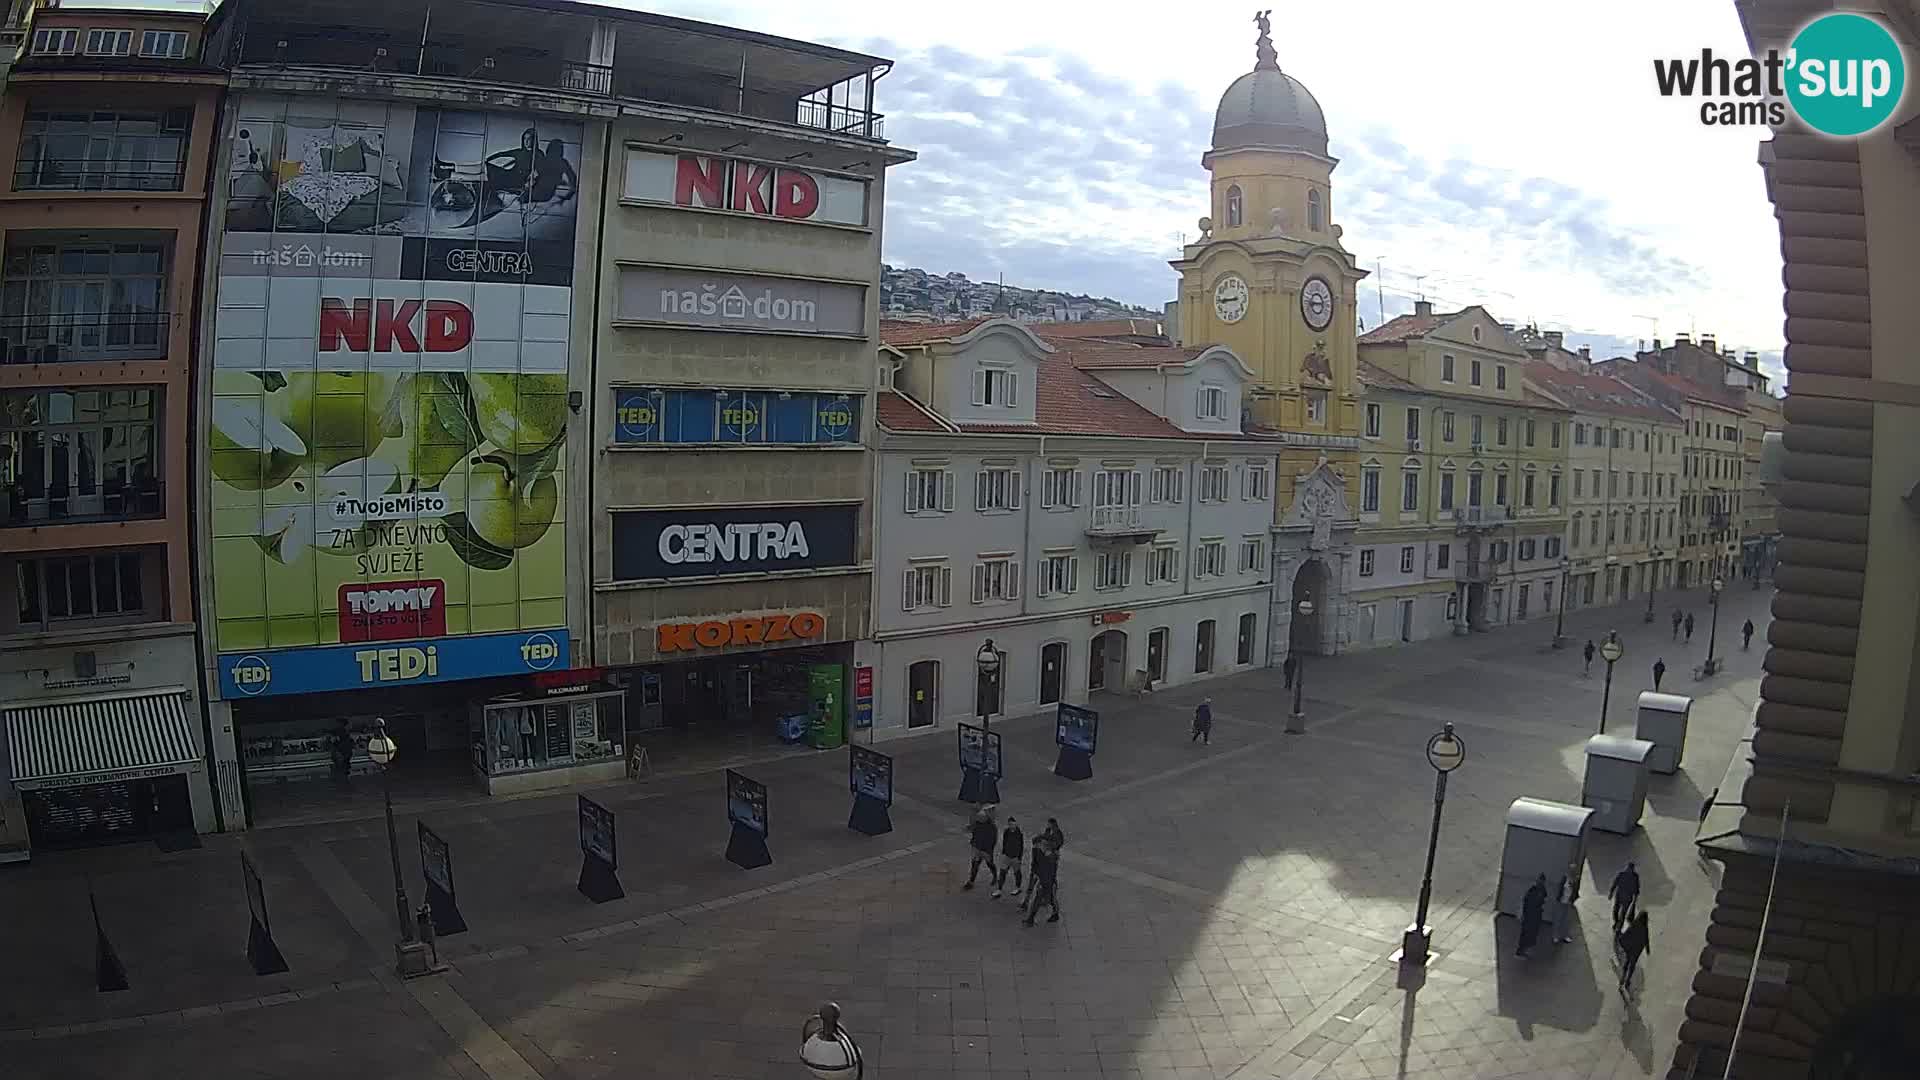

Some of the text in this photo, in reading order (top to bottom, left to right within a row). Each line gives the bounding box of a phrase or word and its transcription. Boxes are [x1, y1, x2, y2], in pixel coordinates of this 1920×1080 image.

[675, 155, 819, 219] NKD
[252, 244, 363, 268] naš dom
[446, 248, 534, 275] CENTRA
[660, 284, 816, 322] naš dom
[318, 296, 475, 353] NKD
[617, 407, 656, 424] TEDi
[723, 409, 758, 425] TEDi
[819, 411, 852, 426] TEDi
[335, 495, 445, 518] #TvojeMisto
[331, 523, 448, 549] ZA DNEVNO
[658, 520, 809, 564] CENTRA
[357, 548, 425, 575] SVJEŽE
[346, 586, 437, 614] TOMMY
[657, 612, 825, 652] KORZO
[356, 645, 438, 682] TEDi
[521, 642, 559, 661] TEDi
[231, 665, 271, 685] TEDi
